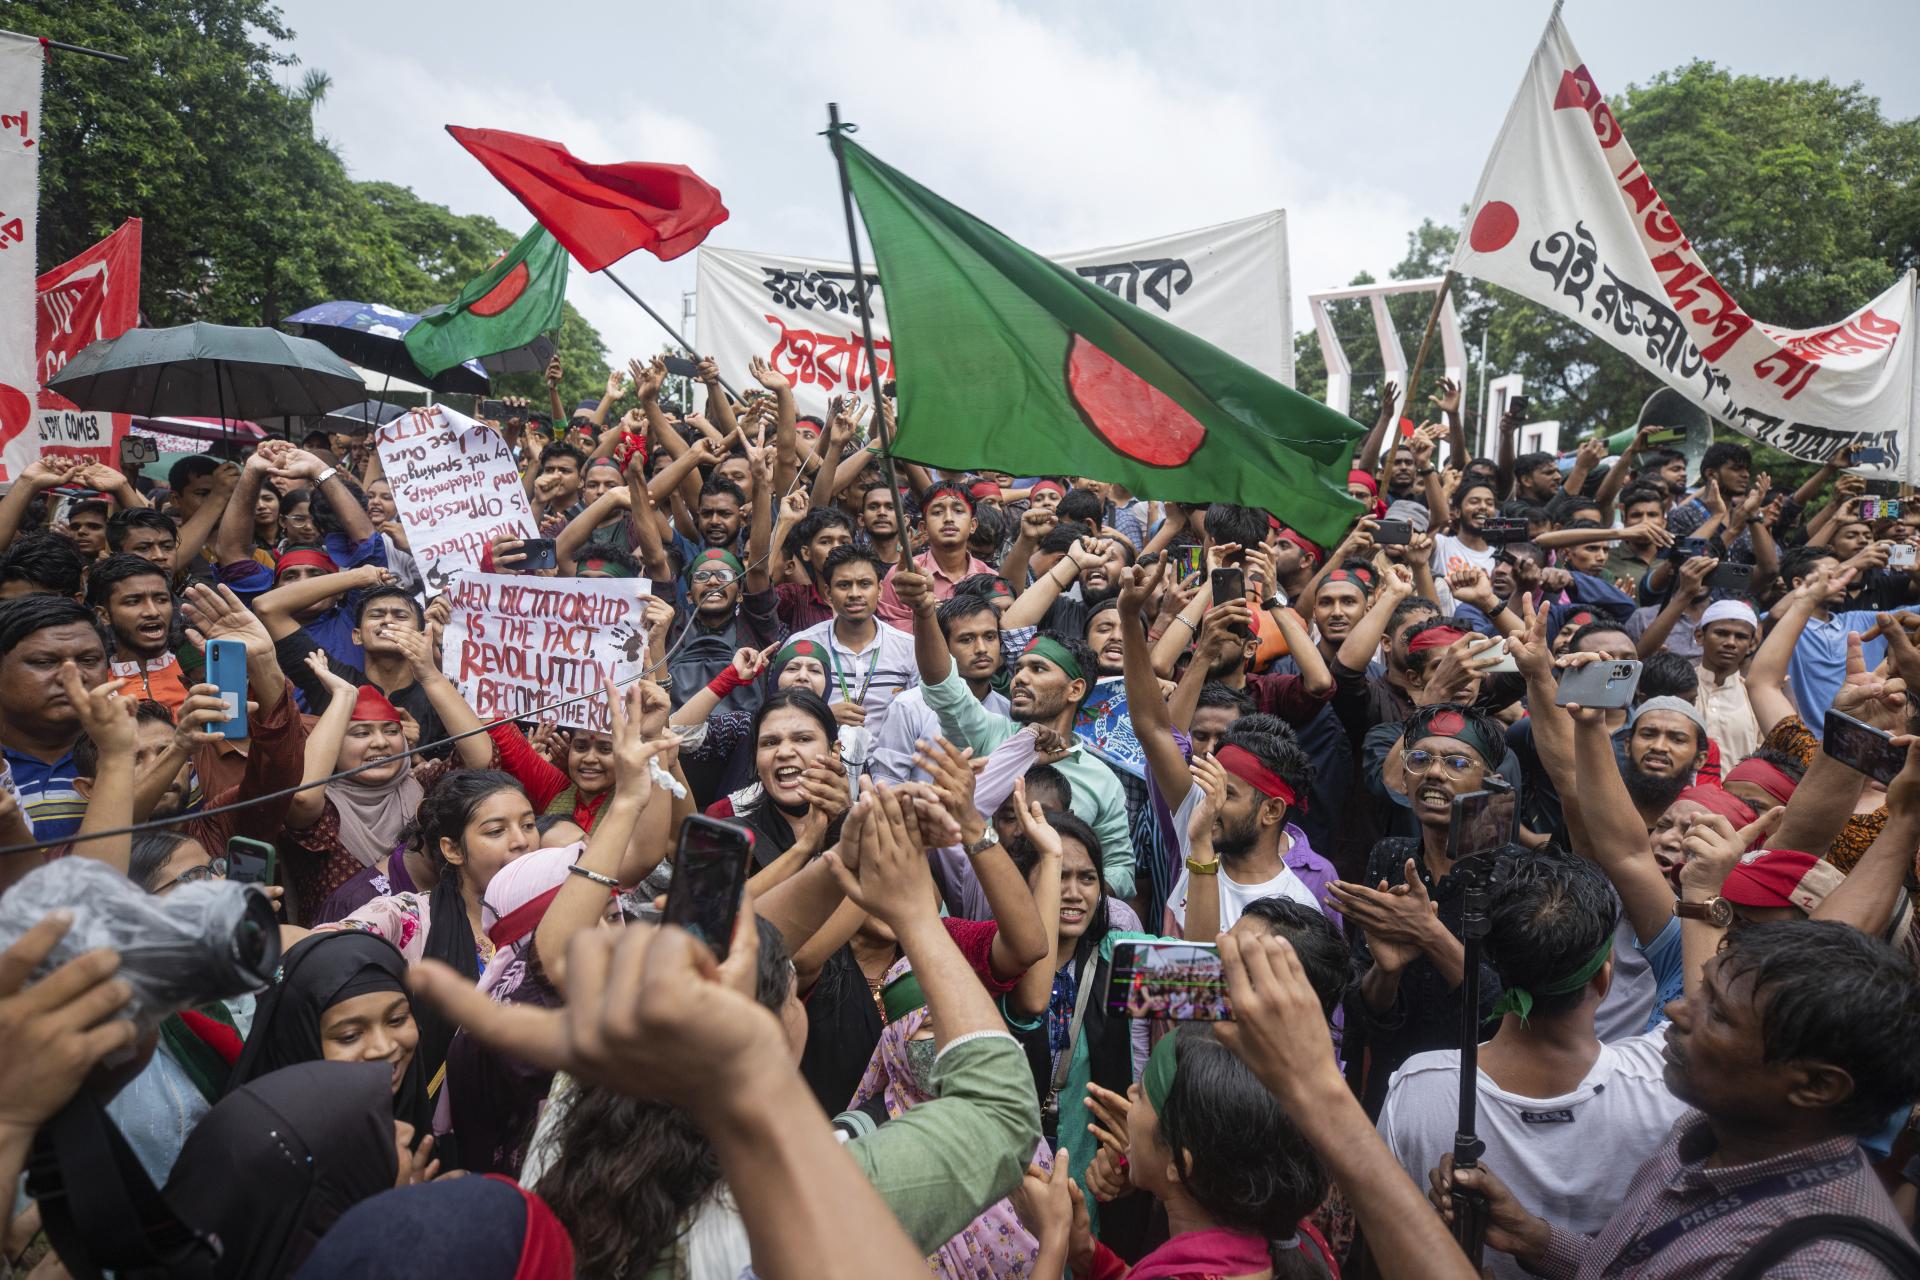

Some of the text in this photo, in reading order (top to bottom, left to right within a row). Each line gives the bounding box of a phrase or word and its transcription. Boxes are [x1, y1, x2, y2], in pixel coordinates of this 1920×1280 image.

[1529, 220, 1599, 314] এই
[764, 314, 896, 392] স্বৈরাচা
[65, 411, 100, 442] COMES
[466, 452, 491, 471] not
[494, 441, 512, 462] by
[493, 470, 518, 492] and
[448, 578, 630, 626] WHEN DICTATORSHIP
[466, 612, 486, 642] IS
[491, 615, 537, 649] THE
[460, 639, 616, 699] REVOLUTION
[476, 677, 560, 724] BECOMES
[557, 700, 586, 725] THE
[1679, 1192, 1744, 1231] PRESS
